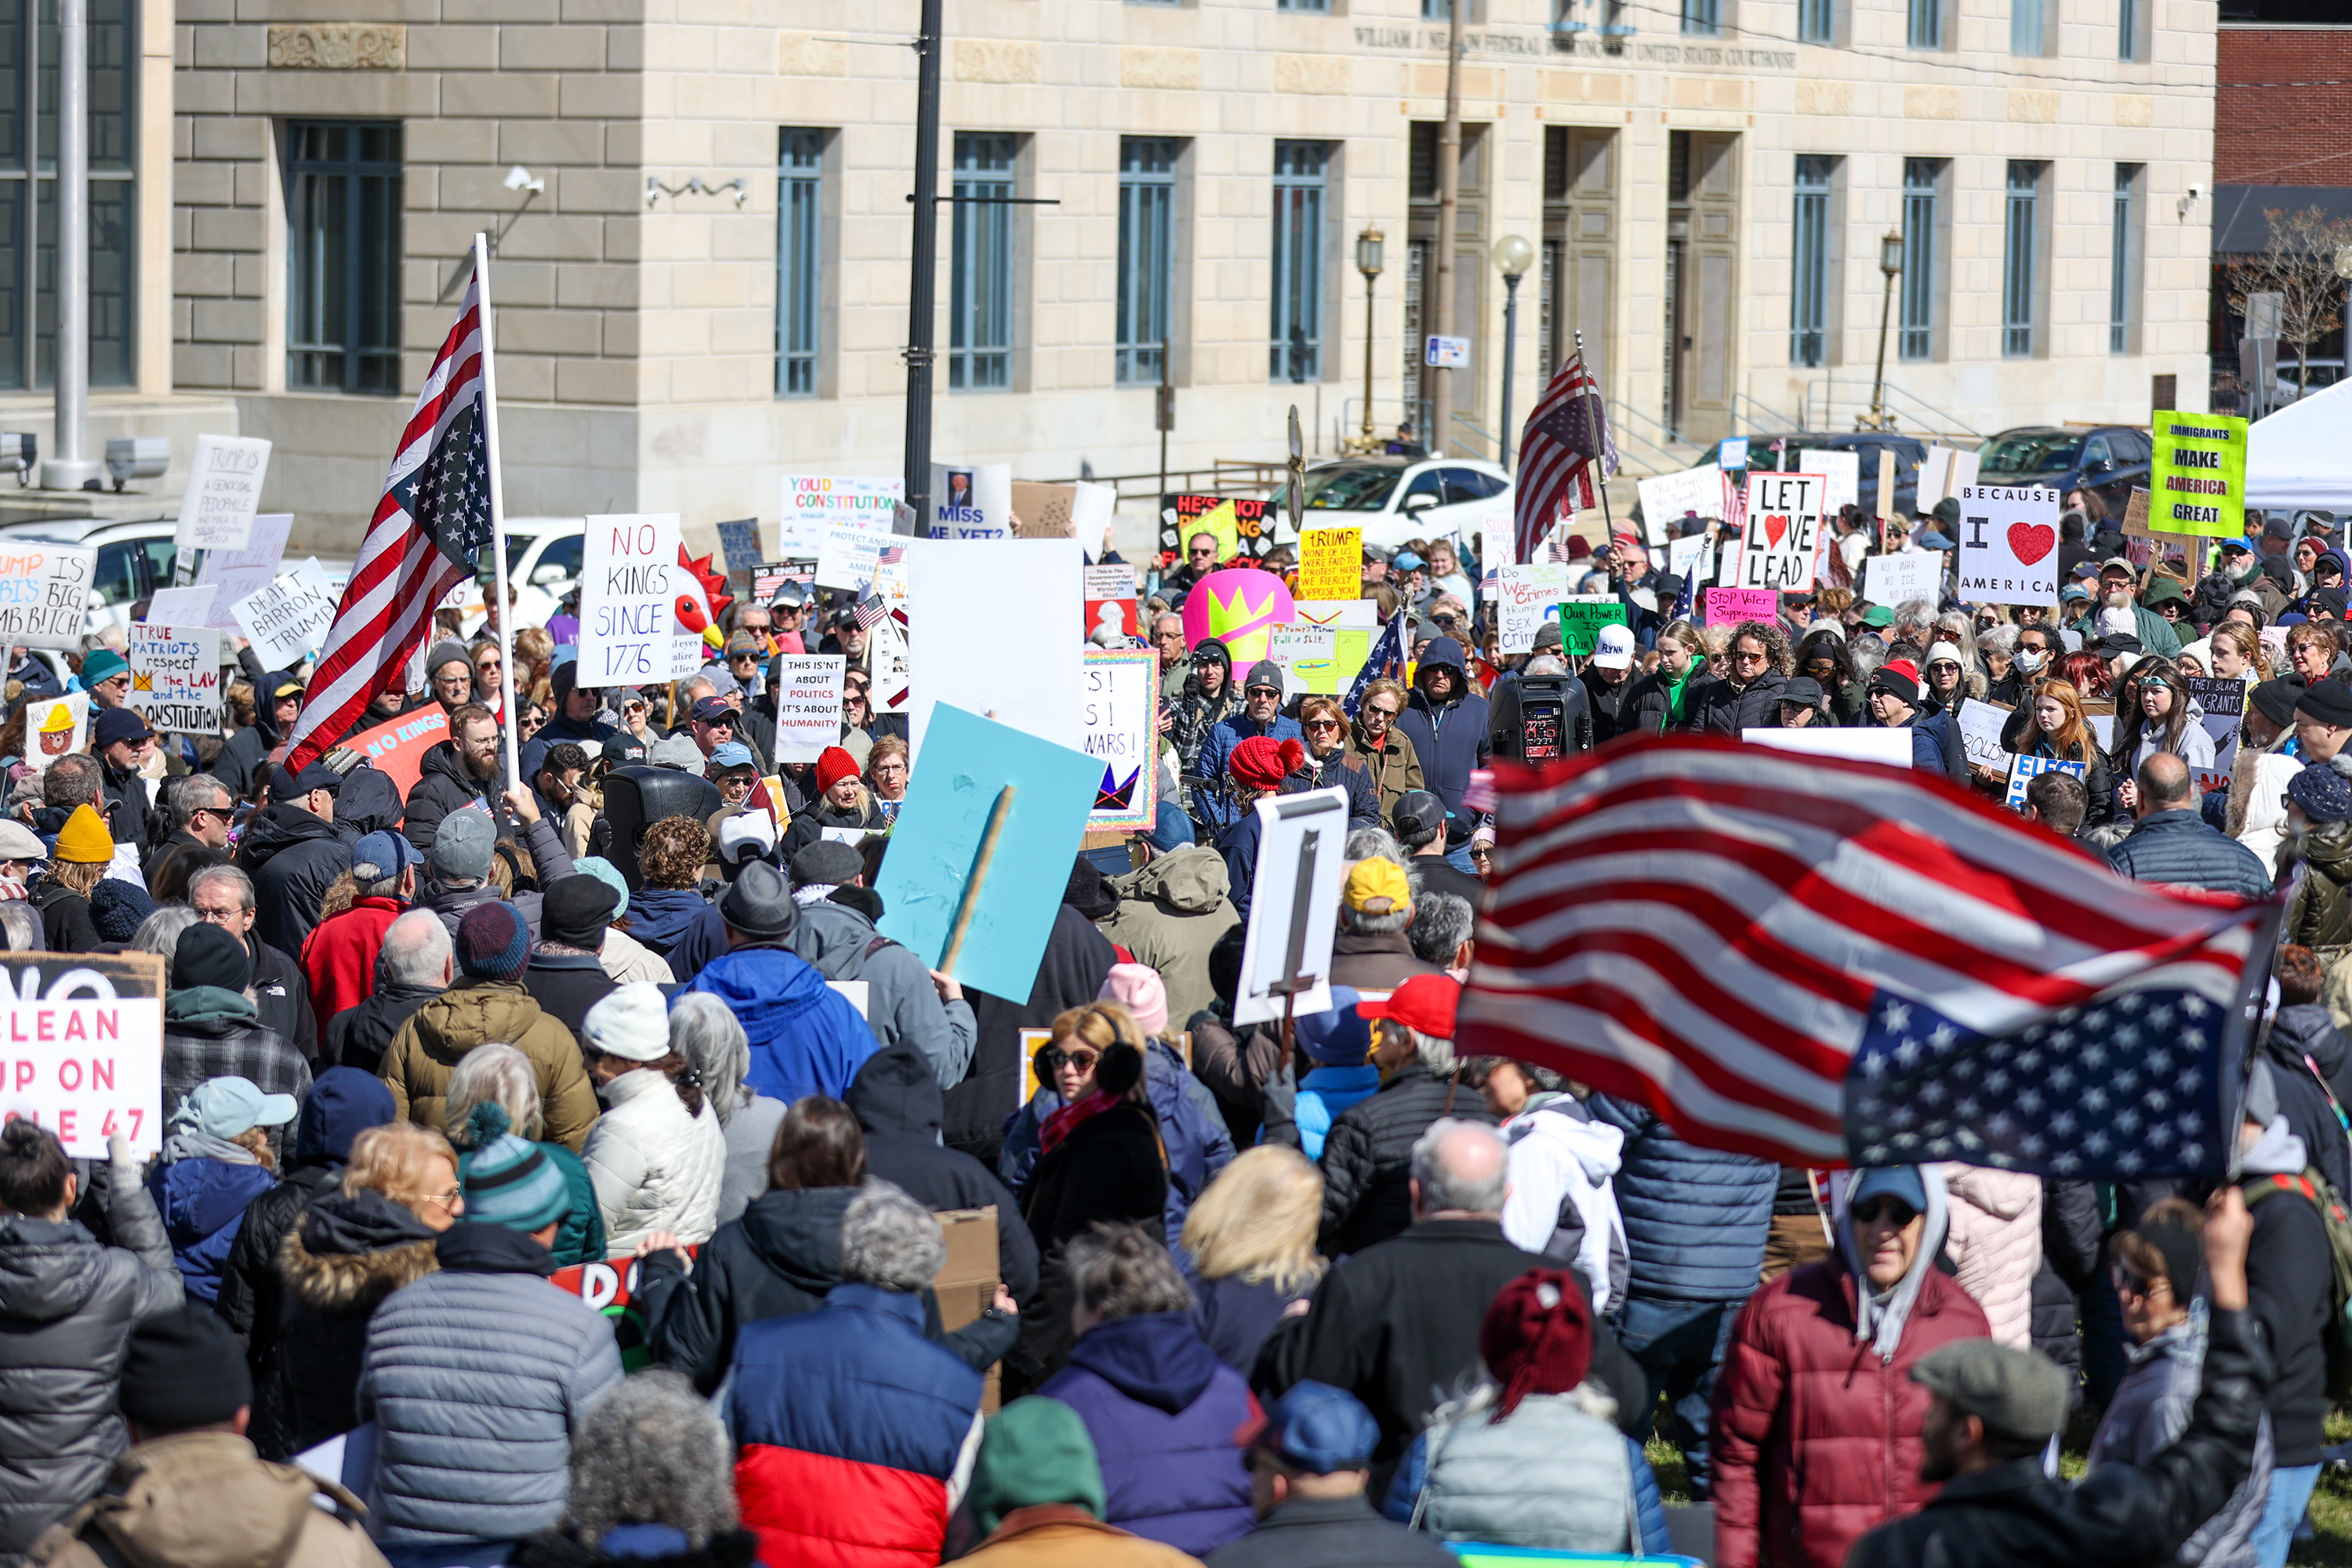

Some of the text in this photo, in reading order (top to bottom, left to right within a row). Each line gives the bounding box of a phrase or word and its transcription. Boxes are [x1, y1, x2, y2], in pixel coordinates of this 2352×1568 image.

[1354, 27, 1413, 49] WILLIAM
[1485, 34, 1542, 56] FEDERAL
[1637, 43, 1680, 64] UNITED
[1684, 45, 1722, 65] STATES
[1725, 47, 1797, 70] COURTHOUSE
[2170, 424, 2230, 441] IMMIGRANTS
[210, 447, 260, 470] TRUMP IS
[1722, 456, 1744, 464] KINGS
[2174, 448, 2219, 469] MAKE
[204, 478, 254, 492] A GENOCIDAL
[2165, 475, 2227, 495] AMERICA
[796, 493, 895, 511] CONSTITUTION
[1761, 479, 1811, 511] LET
[1963, 487, 2056, 503] BECAUSE
[199, 495, 251, 514] PEDOPHILE
[1177, 495, 1219, 514] HE'S
[938, 506, 984, 523] MISS
[2172, 503, 2219, 524] GREAT
[202, 535, 229, 543] AMERICA
[612, 524, 655, 556] NO
[829, 531, 887, 547] PROTECT AND
[958, 528, 1004, 539] YET?
[1965, 516, 1990, 550] I
[1237, 537, 1251, 557] A
[1302, 546, 1352, 558] NONE OF US
[848, 562, 894, 576] AMERAN
[1302, 556, 1357, 567] WERE PAID TO
[1880, 561, 1916, 572] NO WAR
[49, 557, 87, 583] IS
[753, 564, 815, 579] NO KINGS IN
[1303, 564, 1360, 576] PROTEST HERE!
[1501, 568, 1519, 579] Do
[1748, 554, 1803, 586] LEAD
[1301, 574, 1352, 586] WE FIERCLY
[1884, 574, 1915, 586] NO ICE
[1961, 576, 2055, 593] AMERICA
[248, 570, 302, 615] DRAFT
[1301, 586, 1356, 597] OPPOSE YOU
[1502, 581, 1531, 596] War
[1515, 587, 1559, 604] Crimes
[1889, 590, 1899, 600] NO
[1708, 590, 1771, 608] STOP Voter
[252, 584, 322, 637] BARRON
[595, 604, 663, 637] SINCE
[1273, 623, 1311, 633] Trump's
[1506, 617, 1532, 632] SEX
[1582, 621, 1600, 631] IS
[135, 625, 172, 641] TRUE
[1273, 635, 1291, 645] Full
[132, 641, 200, 655] PATRIOTS
[679, 640, 699, 650] eyes
[1601, 643, 1624, 655] FLYNN
[146, 655, 198, 673] respect
[605, 643, 651, 676] 1776
[788, 661, 840, 670] THIS IS'NT
[679, 664, 695, 673] lies
[163, 671, 218, 688] the LAW
[2188, 677, 2241, 692] THEY BLAME
[152, 686, 201, 701] and the
[789, 690, 834, 699] POLITICS
[27, 699, 89, 727] ONLY YOU
[804, 705, 839, 713] ABOUT
[782, 719, 837, 728] HUMANITY
[367, 734, 397, 758] NO
[396, 713, 446, 742] KINGS
[1963, 733, 2007, 764] BOLISH
[453, 900, 479, 909] NAUTICA
[0, 1008, 119, 1043] LEAN
[58, 1057, 115, 1092] ON
[101, 1107, 144, 1142] 47
